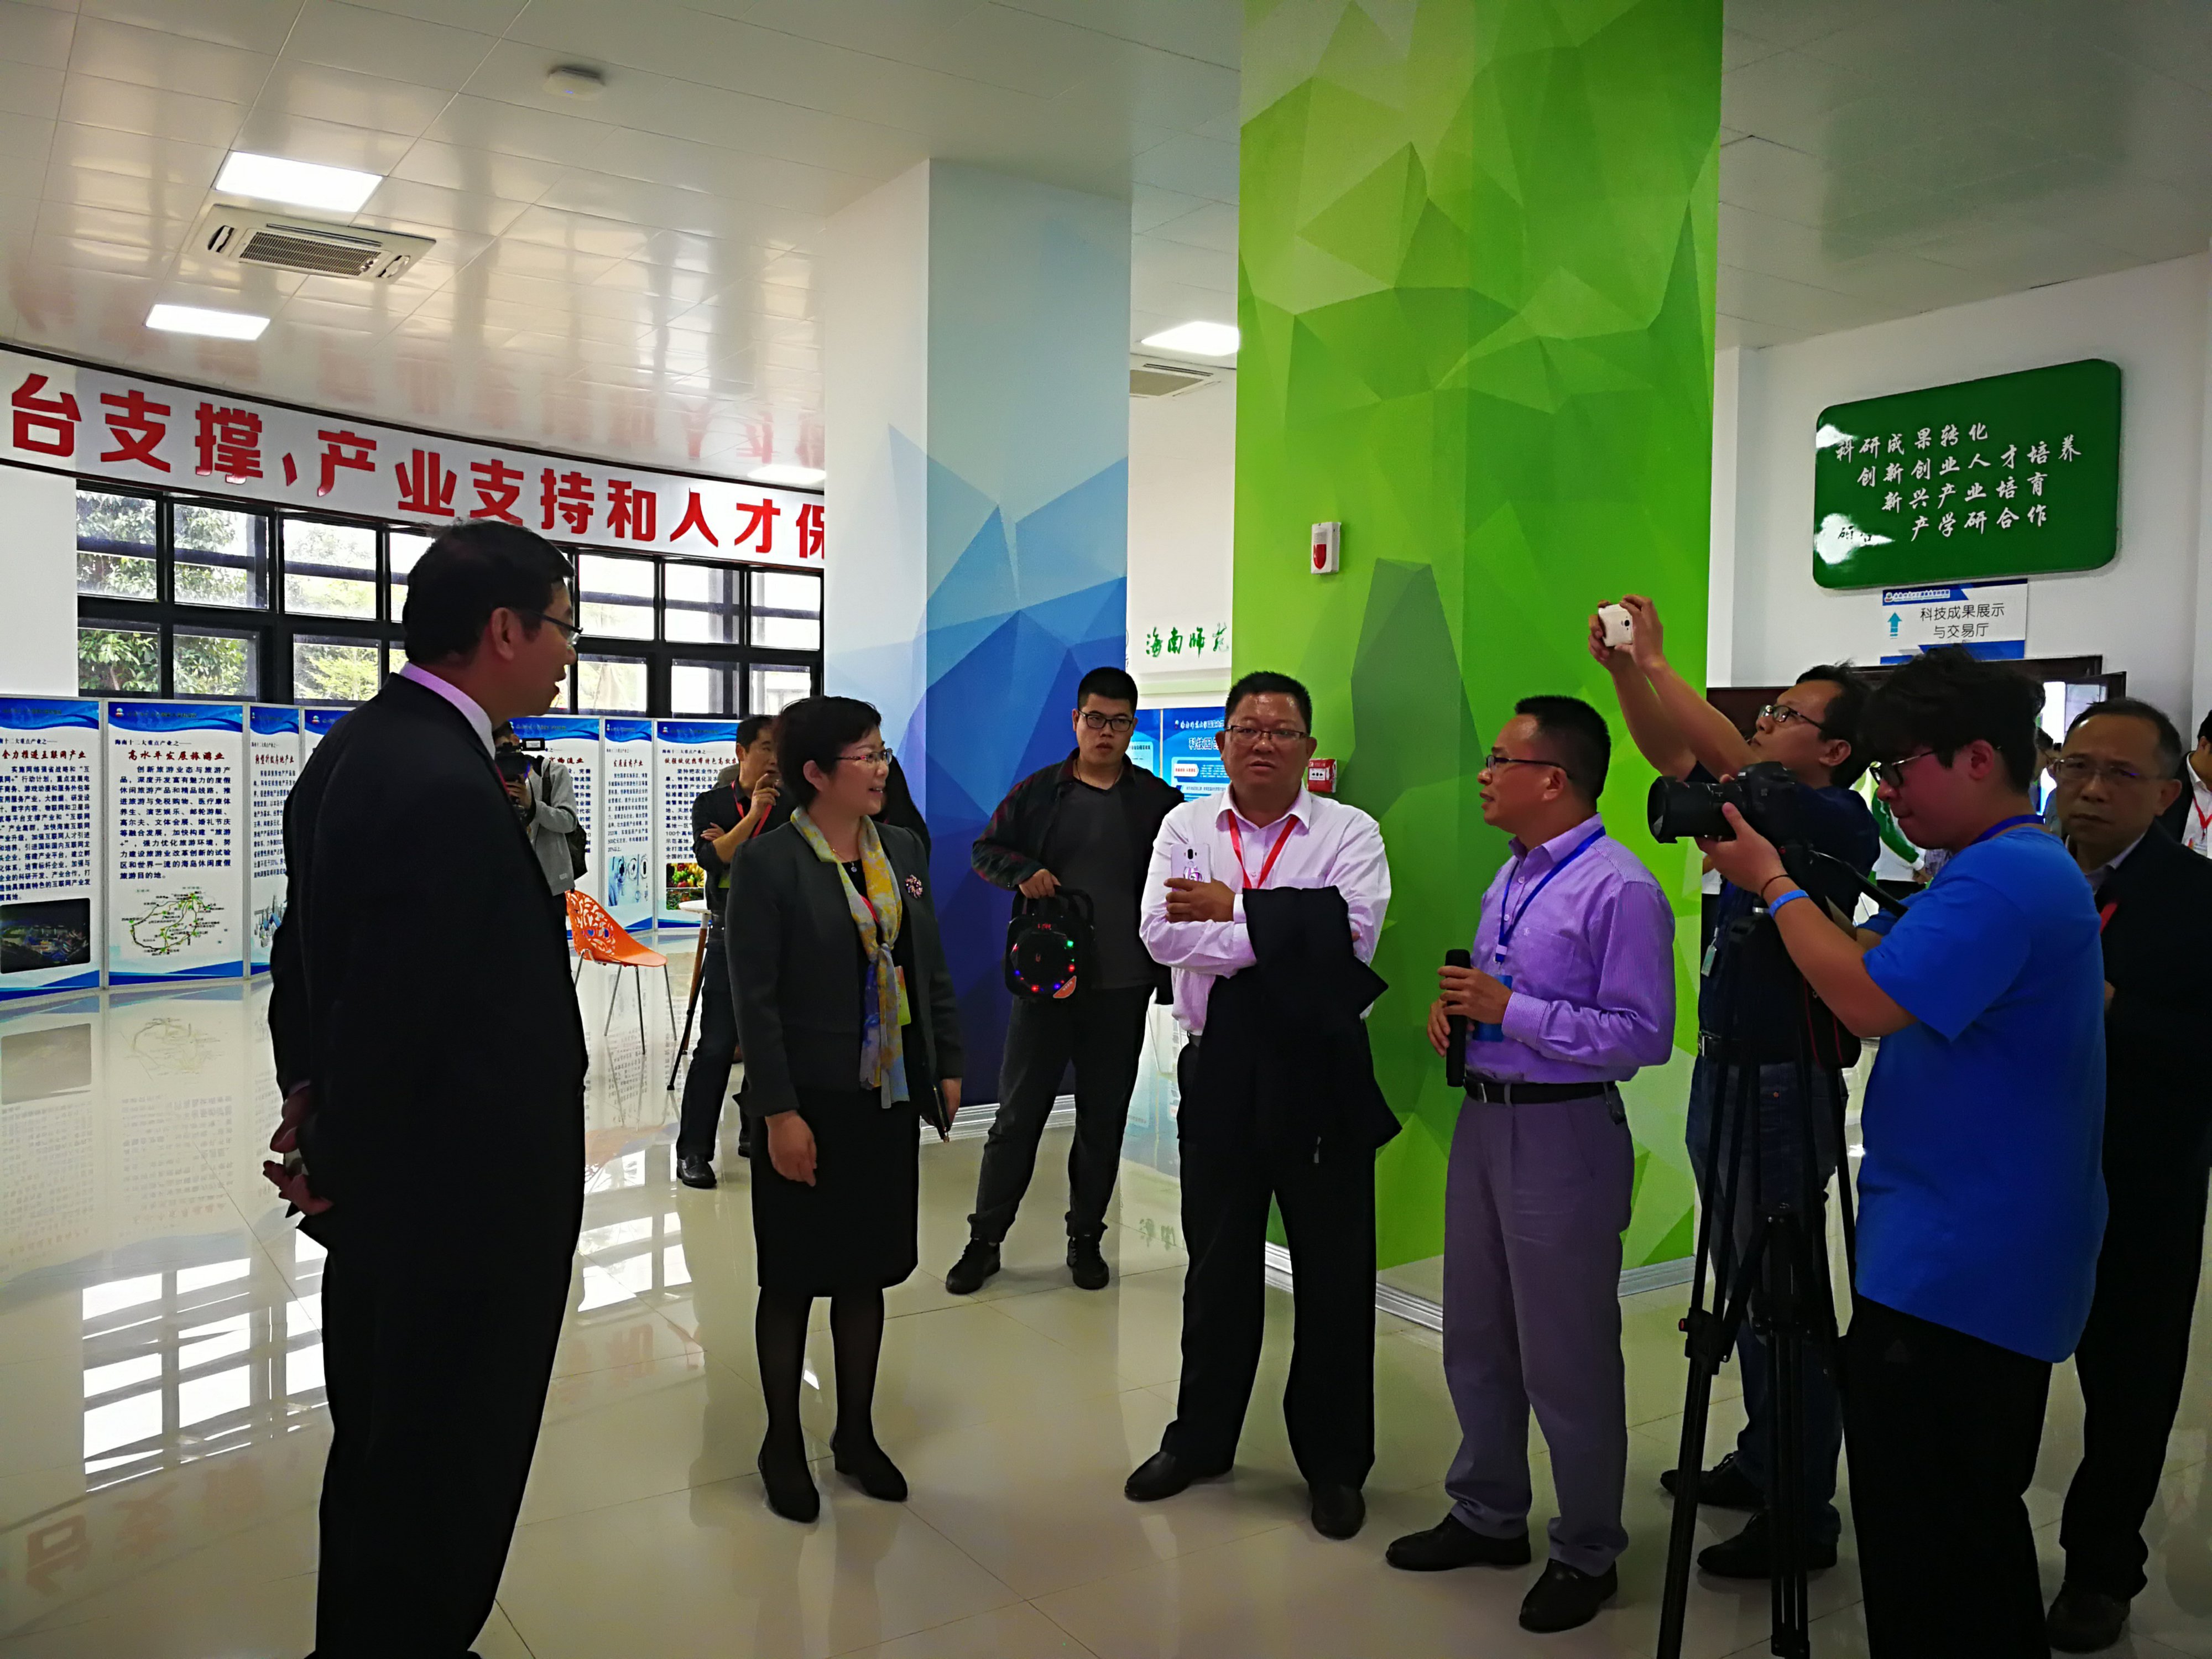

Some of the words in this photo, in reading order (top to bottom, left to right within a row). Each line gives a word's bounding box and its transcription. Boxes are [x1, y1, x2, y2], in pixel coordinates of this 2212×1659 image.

[1835, 422, 1988, 463] 科研成果转化
[1857, 434, 2081, 487] 创新创业人才培养
[1881, 472, 2047, 513] 新兴产业培育
[1911, 504, 2047, 541] 产学研合作
[1920, 602, 2005, 622] 科技成果展示
[1933, 623, 1989, 639] 与交易厅
[2, 749, 86, 760] 全力推进互联网产业
[128, 749, 225, 761] 高水平发展旅游业
